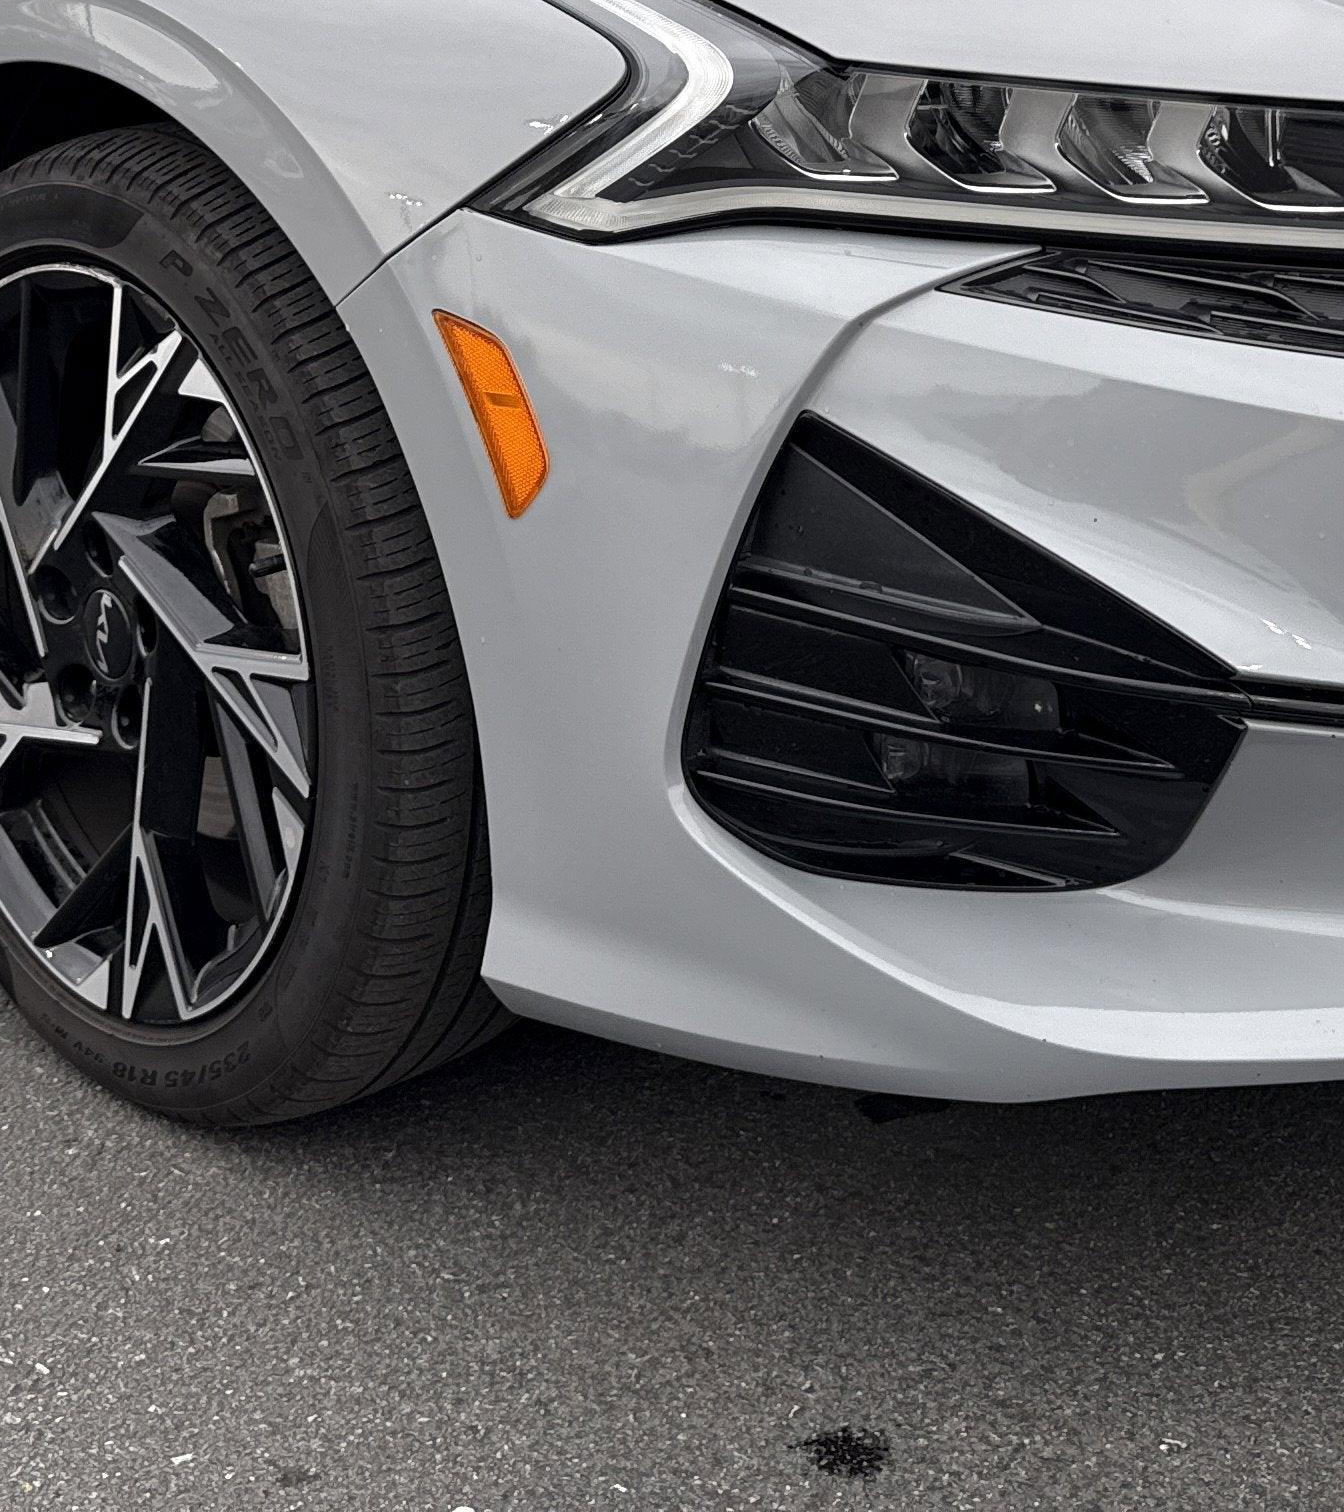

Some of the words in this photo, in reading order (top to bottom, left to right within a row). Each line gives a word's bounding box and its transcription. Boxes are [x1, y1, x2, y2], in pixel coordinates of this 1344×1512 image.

[193, 286, 305, 460] ZERO
[111, 1061, 158, 1086] R18
[164, 1041, 252, 1088] 235/45
